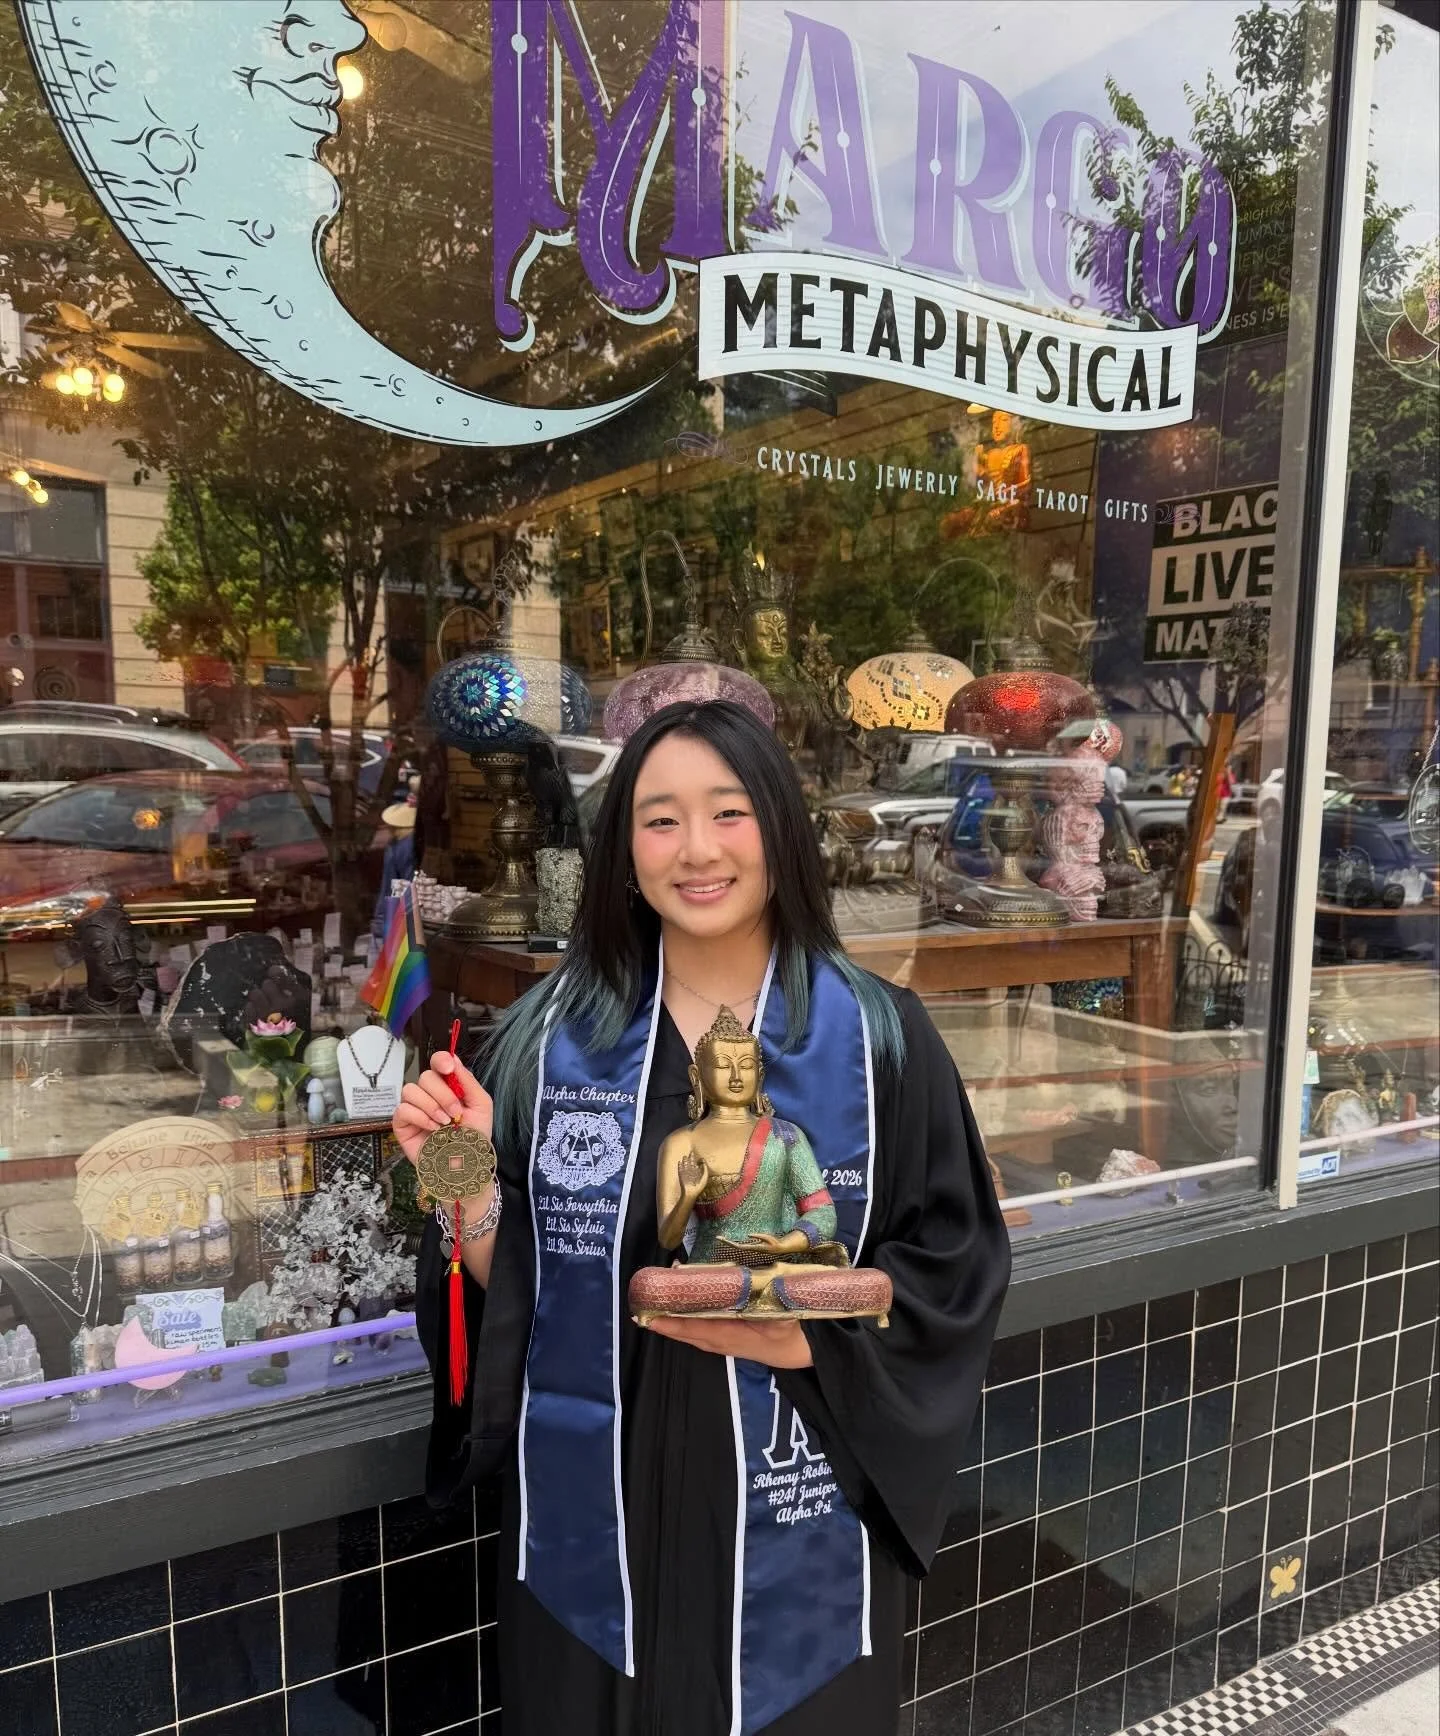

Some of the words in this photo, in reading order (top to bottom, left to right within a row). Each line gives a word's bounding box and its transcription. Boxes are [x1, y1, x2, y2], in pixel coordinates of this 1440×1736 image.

[1239, 216, 1286, 245] UMAN
[1238, 242, 1286, 272] IENCE
[1262, 305, 1275, 323] IS
[722, 272, 1181, 413] METAPHYSICAL
[757, 446, 856, 482] CRYSTALS
[875, 464, 958, 496] JEWERLY
[976, 479, 1019, 502] SAGE
[1036, 488, 1088, 514] TAROT
[1104, 499, 1149, 523] GIFTS
[1173, 489, 1279, 538] BLAC
[1163, 545, 1276, 605] LIVE
[1155, 618, 1229, 652] MAT
[543, 1086, 577, 1104] Alpha
[579, 1086, 636, 1105] Chapter
[831, 1169, 863, 1187] 2026
[538, 1196, 550, 1211] Lil
[551, 1197, 563, 1212] Sis
[564, 1197, 619, 1217] Forsythia
[546, 1217, 557, 1232] Lil
[559, 1218, 571, 1233] Sis
[572, 1218, 606, 1238] Sylvie
[547, 1236, 556, 1252] Lil
[558, 1238, 573, 1254] Bro
[575, 1239, 607, 1257] Sirius
[157, 1309, 199, 1327] Sale
[753, 1471, 800, 1489] Rhenay
[768, 1487, 796, 1506] #241
[798, 1482, 838, 1504] Juniper
[776, 1506, 812, 1526] Alpha
[814, 1500, 833, 1514] Psi
